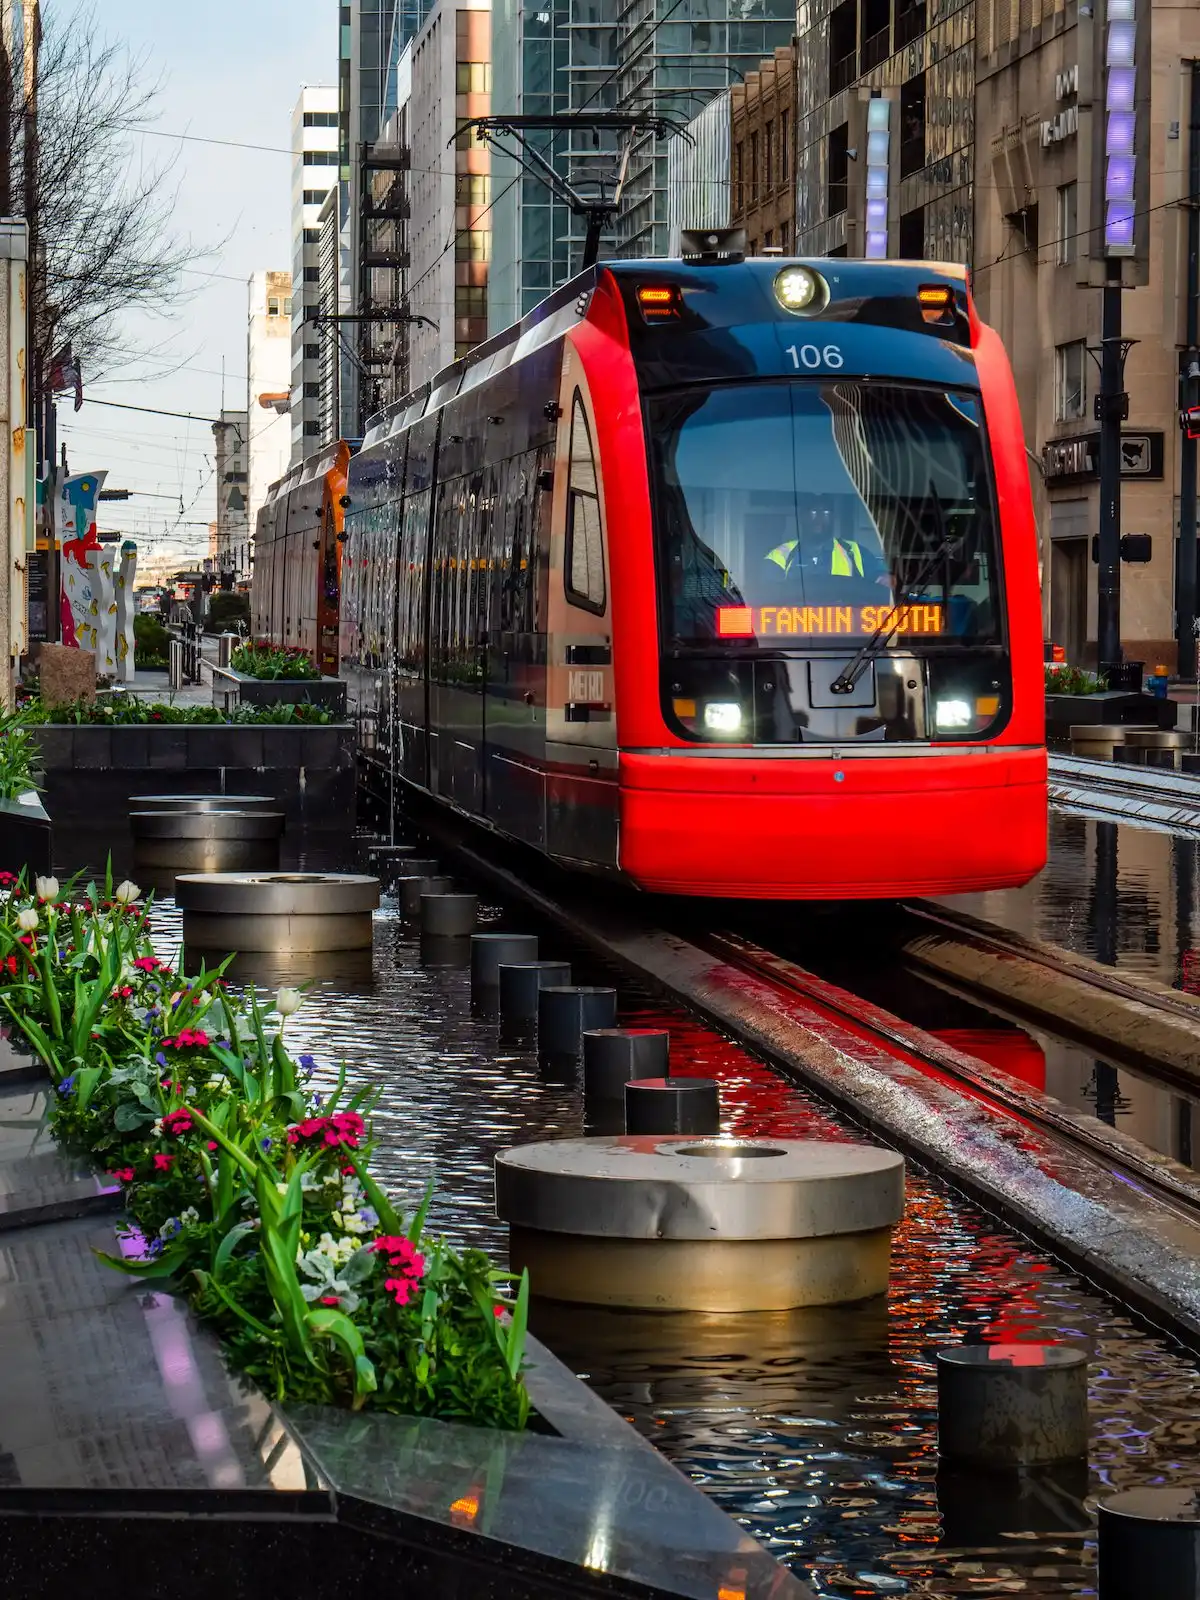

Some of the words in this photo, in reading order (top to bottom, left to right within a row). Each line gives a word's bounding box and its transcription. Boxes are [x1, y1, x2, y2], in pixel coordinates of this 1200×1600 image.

[785, 344, 844, 369] 106
[760, 607, 852, 633] FANNIN
[861, 606, 941, 633] SOUTH
[568, 670, 604, 701] METRO
